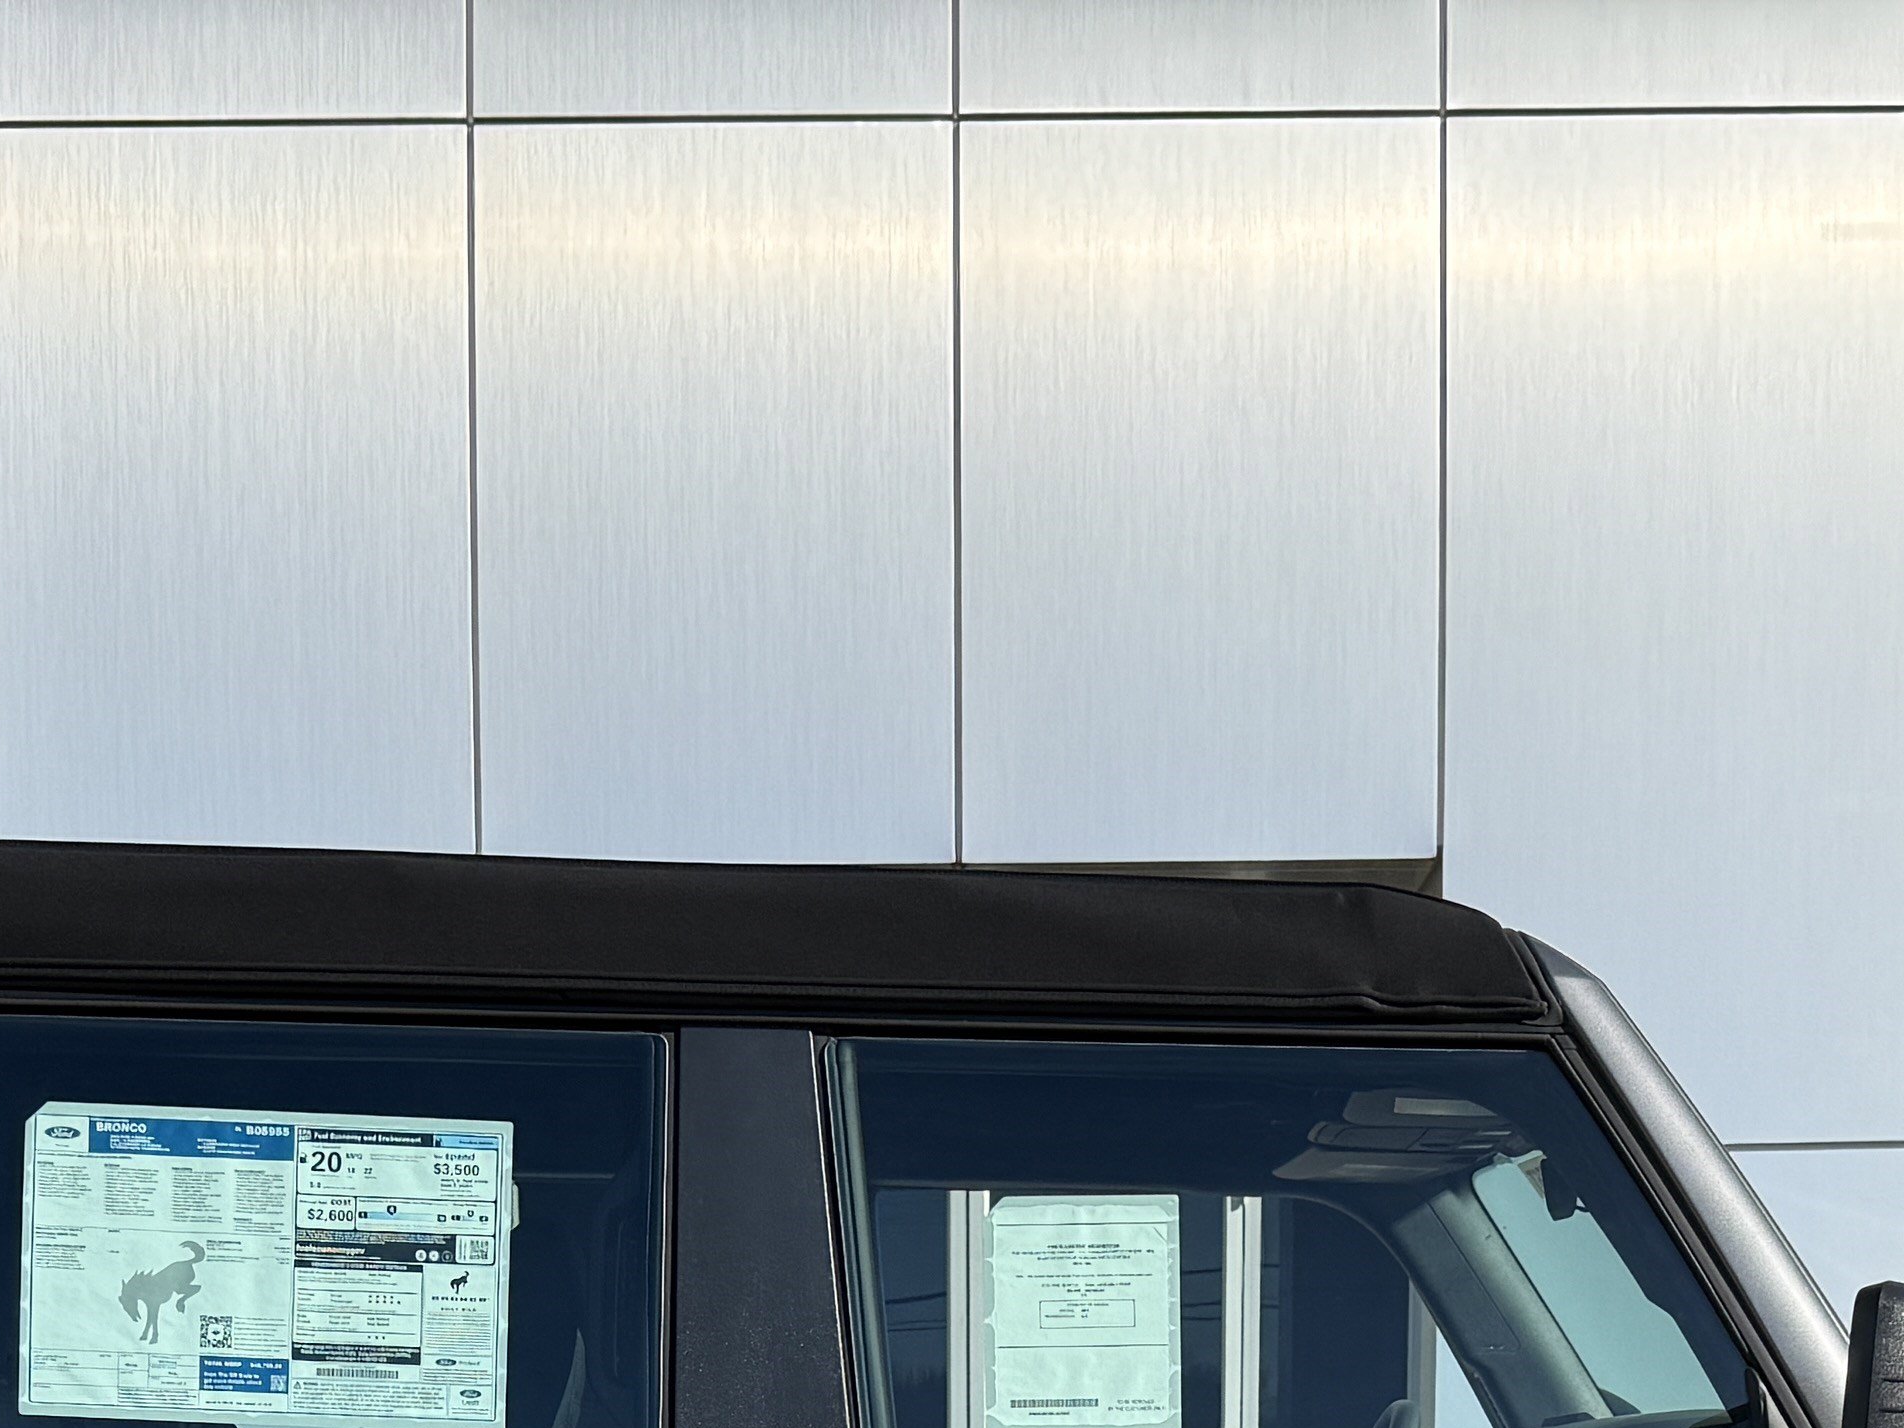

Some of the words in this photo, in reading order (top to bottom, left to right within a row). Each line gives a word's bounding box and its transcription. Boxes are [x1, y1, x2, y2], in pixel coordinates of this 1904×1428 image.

[96, 1120, 147, 1134] BRONCO
[310, 1151, 342, 1173] 20
[433, 1162, 480, 1177] $3,500
[307, 1208, 354, 1222] $2,600
